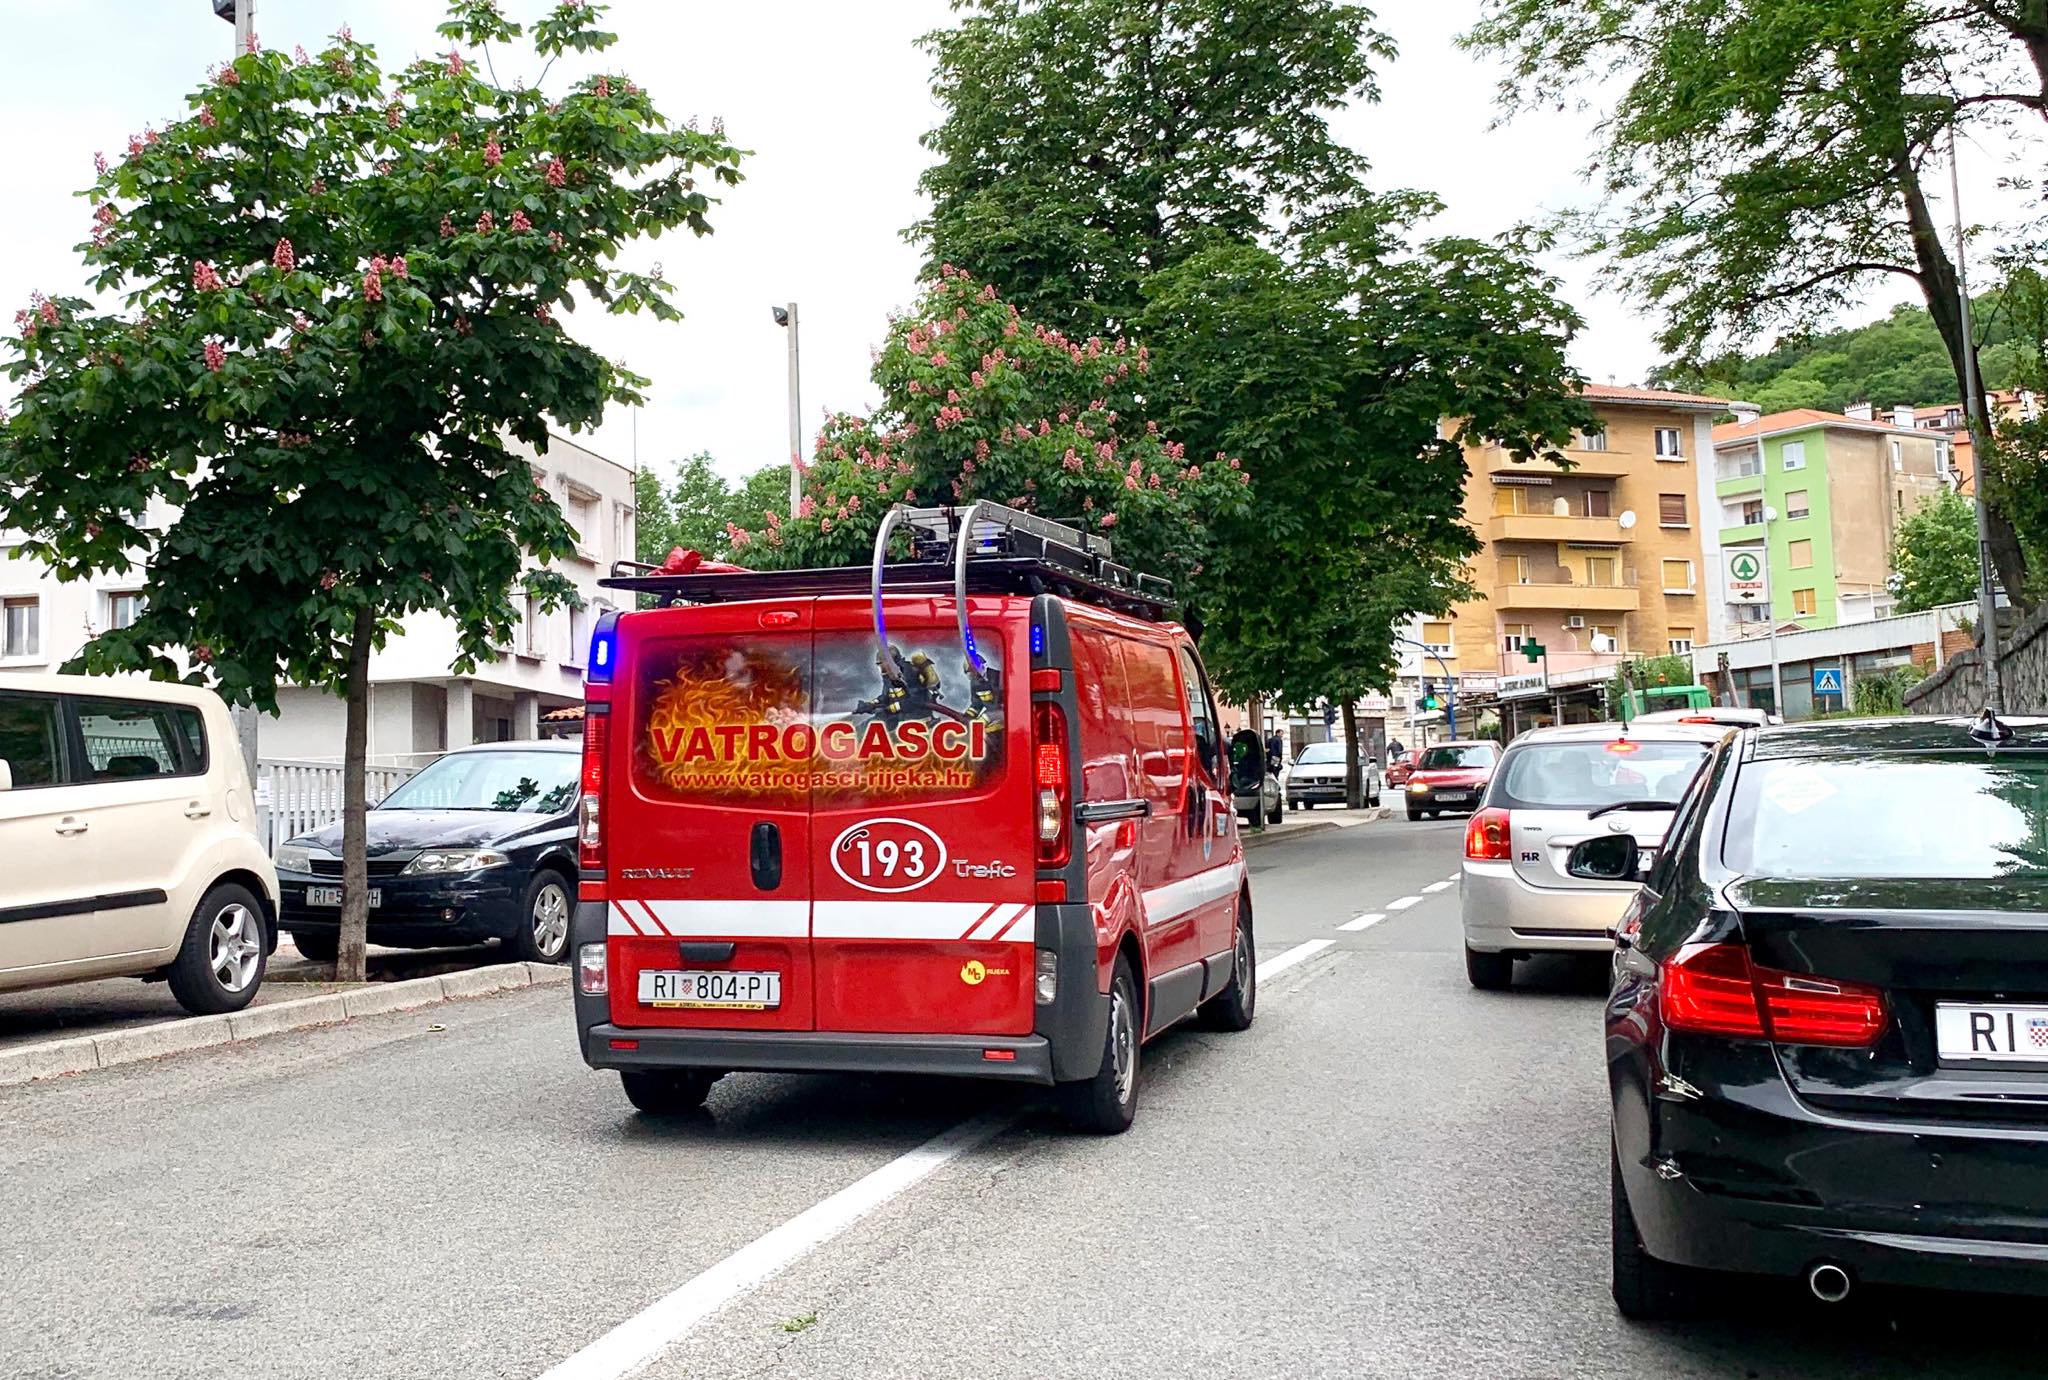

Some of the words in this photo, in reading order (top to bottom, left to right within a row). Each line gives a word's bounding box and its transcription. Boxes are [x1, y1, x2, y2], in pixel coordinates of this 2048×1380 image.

[652, 721, 985, 763] VATROGASCI
[673, 768, 972, 790] www.vatrogasci-rijeka.hr
[857, 840, 925, 878] 193
[1521, 852, 1540, 862] HR
[621, 868, 695, 879] RENAULT
[952, 859, 1017, 879] Trafic
[314, 889, 326, 904] RI
[654, 975, 675, 998] RI
[697, 975, 771, 1000] 804-PI
[1970, 1012, 2015, 1052] RI
